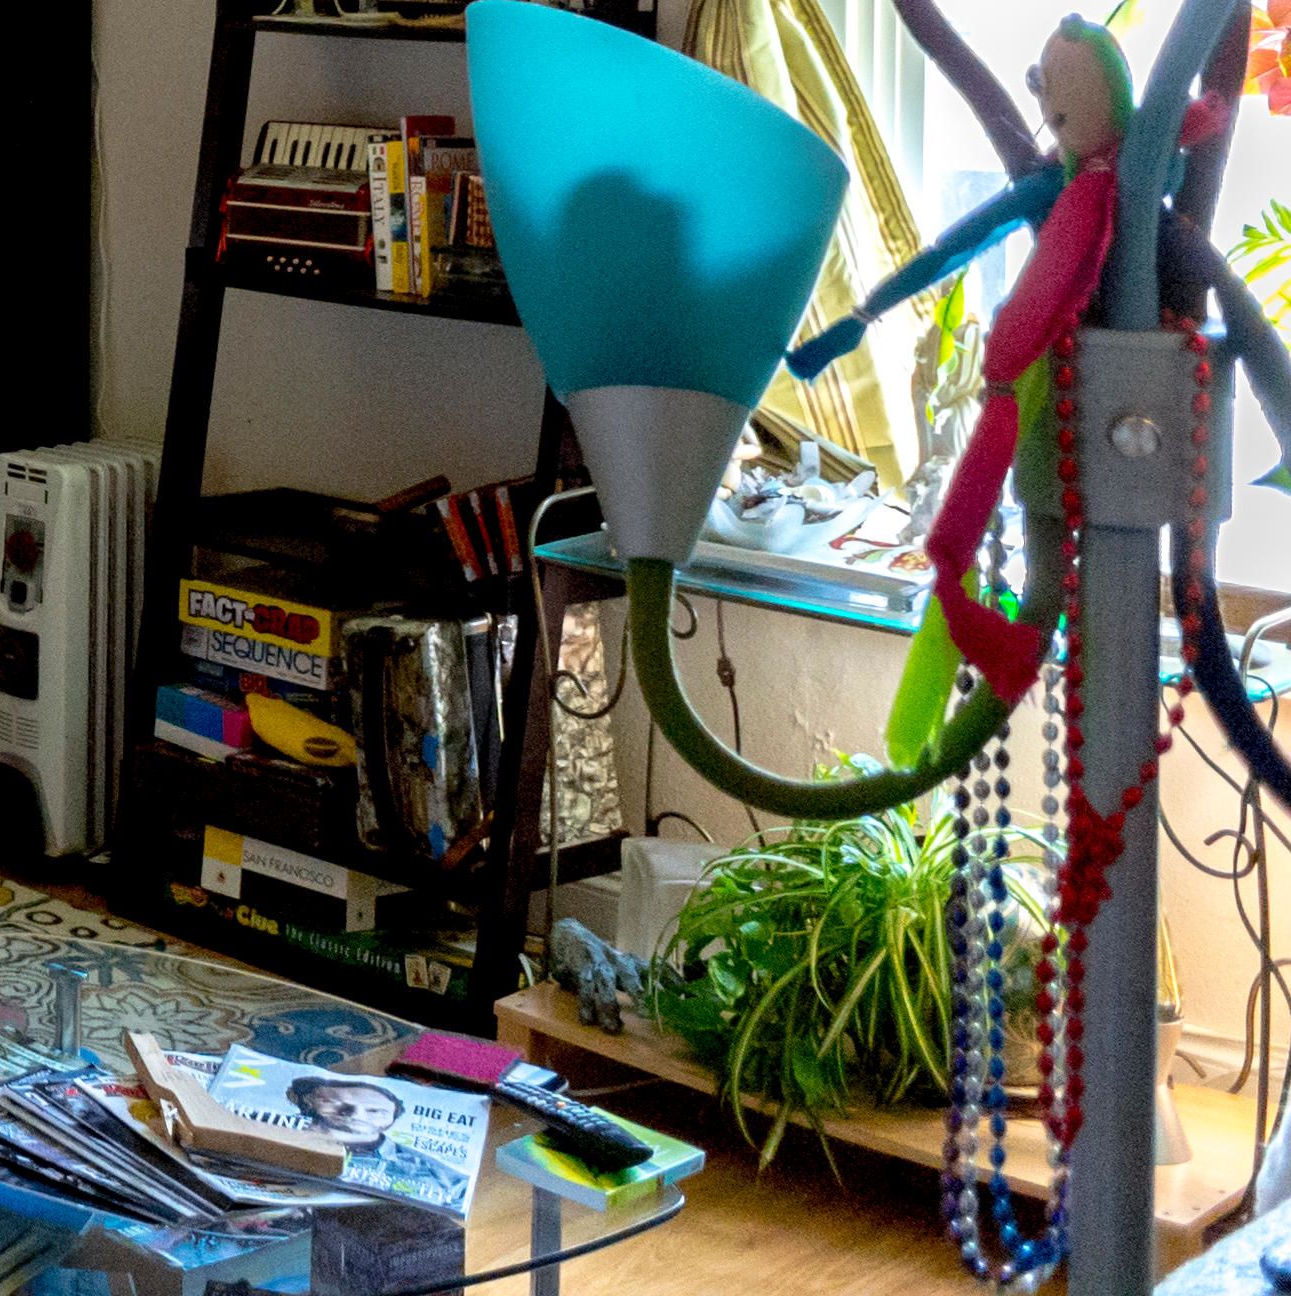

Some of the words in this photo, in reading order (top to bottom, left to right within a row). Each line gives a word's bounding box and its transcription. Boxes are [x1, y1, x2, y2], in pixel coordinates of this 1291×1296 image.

[371, 176, 387, 226] ITALY
[212, 631, 323, 678] SEQUENCE
[242, 850, 267, 868] SAN
[269, 855, 334, 888] FRANCISCO
[236, 904, 280, 936] Clue
[413, 1105, 443, 1120] BIG
[447, 1111, 477, 1128] EAT
